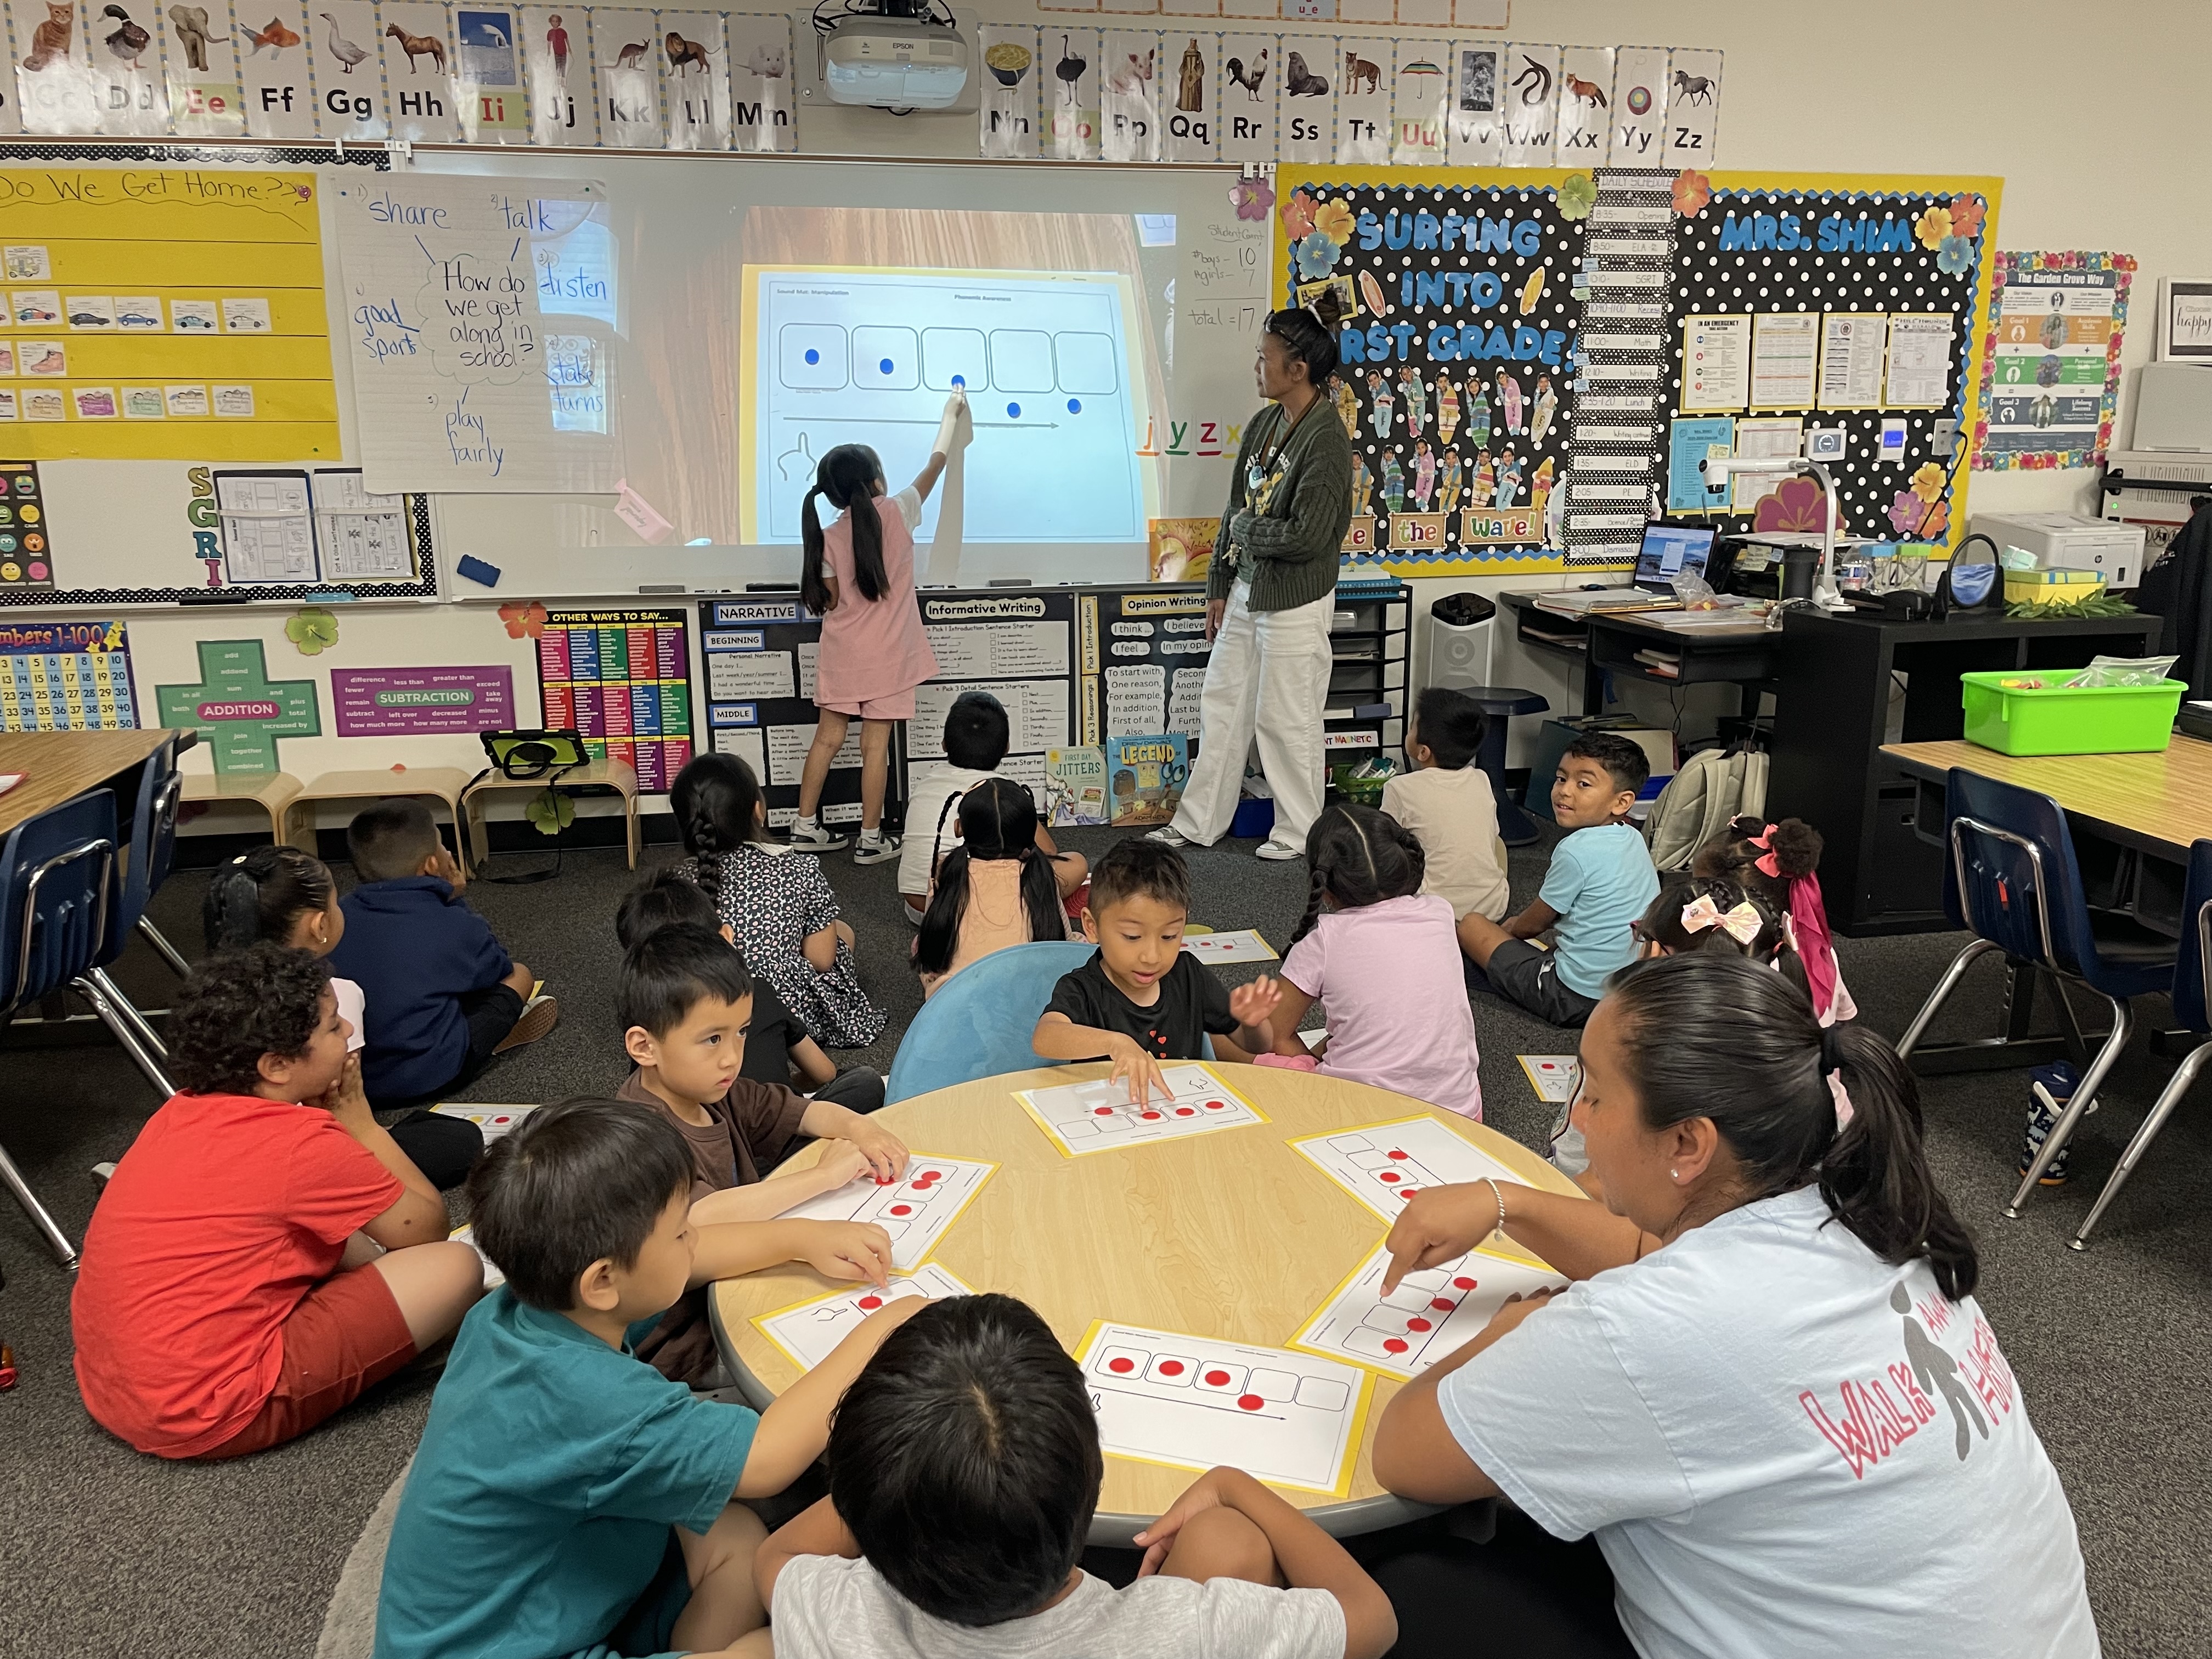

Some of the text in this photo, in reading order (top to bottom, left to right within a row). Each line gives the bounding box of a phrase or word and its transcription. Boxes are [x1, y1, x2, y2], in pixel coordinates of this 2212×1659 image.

[110, 85, 153, 110] Dd
[185, 90, 225, 114] Ee
[261, 87, 294, 112] Ff
[327, 89, 372, 121] Gg
[400, 91, 443, 116] Hh
[482, 98, 504, 122] Ii
[610, 98, 650, 122] Kk
[685, 100, 708, 124] Ll
[991, 110, 1028, 134] Nn
[1051, 115, 1092, 139] Oo
[1113, 114, 1147, 138] Pp
[1170, 115, 1210, 145] Qq
[1233, 119, 1262, 139] Rr
[1291, 121, 1318, 140] Ss
[1349, 121, 1375, 142] Tt
[1403, 123, 1437, 148] Uu
[1459, 123, 1490, 144] Vv
[1506, 124, 1550, 148] Ww
[1566, 127, 1599, 149] Xx
[1621, 127, 1651, 154] Yy
[1675, 128, 1702, 149] Zz
[47, 174, 104, 199] We
[122, 172, 174, 196] Get
[1601, 177, 1672, 187] DAILY SCHEDULE
[369, 191, 451, 229] share
[498, 196, 555, 231] talk
[1638, 211, 1664, 220] Opening
[1357, 212, 1542, 256] SURFING
[1719, 215, 1912, 253] MRS. SHIM
[1239, 247, 1255, 267] 10
[1633, 243, 1646, 251] ELA
[443, 261, 524, 294] How do
[548, 262, 607, 300] listen
[1243, 269, 1255, 287] 7
[1402, 270, 1502, 308] INTO
[1635, 275, 1656, 284] SGRI
[2018, 273, 2104, 285] The Garden Grove Way
[354, 298, 403, 336] good
[445, 296, 523, 329] we get
[1188, 308, 1222, 325] total
[1638, 304, 1661, 314] Recess
[2177, 307, 2211, 338] happy
[450, 321, 533, 353] along in
[1340, 325, 1416, 364] RST
[1634, 338, 1651, 347] Math
[460, 343, 534, 367] school?
[554, 353, 594, 386] take
[1629, 368, 1652, 377] Writing
[553, 385, 603, 413] turns
[1626, 397, 1644, 406] Lunch
[445, 400, 484, 443] play
[1169, 421, 1187, 449] y
[1200, 423, 1216, 443] z
[1226, 424, 1242, 445] x
[448, 431, 504, 477] fairly
[1398, 514, 1536, 542] the wave!
[720, 607, 794, 619] NARRATIVE
[929, 603, 1041, 614] Informative Writing
[1128, 597, 1206, 610] Opinion Writing
[57, 625, 104, 645] 1-100
[711, 636, 759, 645] BEGINNING
[1120, 624, 1142, 633] think
[1, 659, 8, 668] 3
[50, 658, 55, 666] 6
[112, 656, 121, 664] 10
[1142, 668, 1163, 676] with,
[1131, 680, 1161, 689] reason,
[380, 692, 469, 703] SUBTRACTION
[204, 704, 273, 716] ADDITION
[1335, 735, 1372, 744] MAGNETIC
[1121, 745, 1175, 764] LEGEND
[1056, 762, 1101, 776] JITTERS
[1799, 1362, 1936, 1480] WALK
